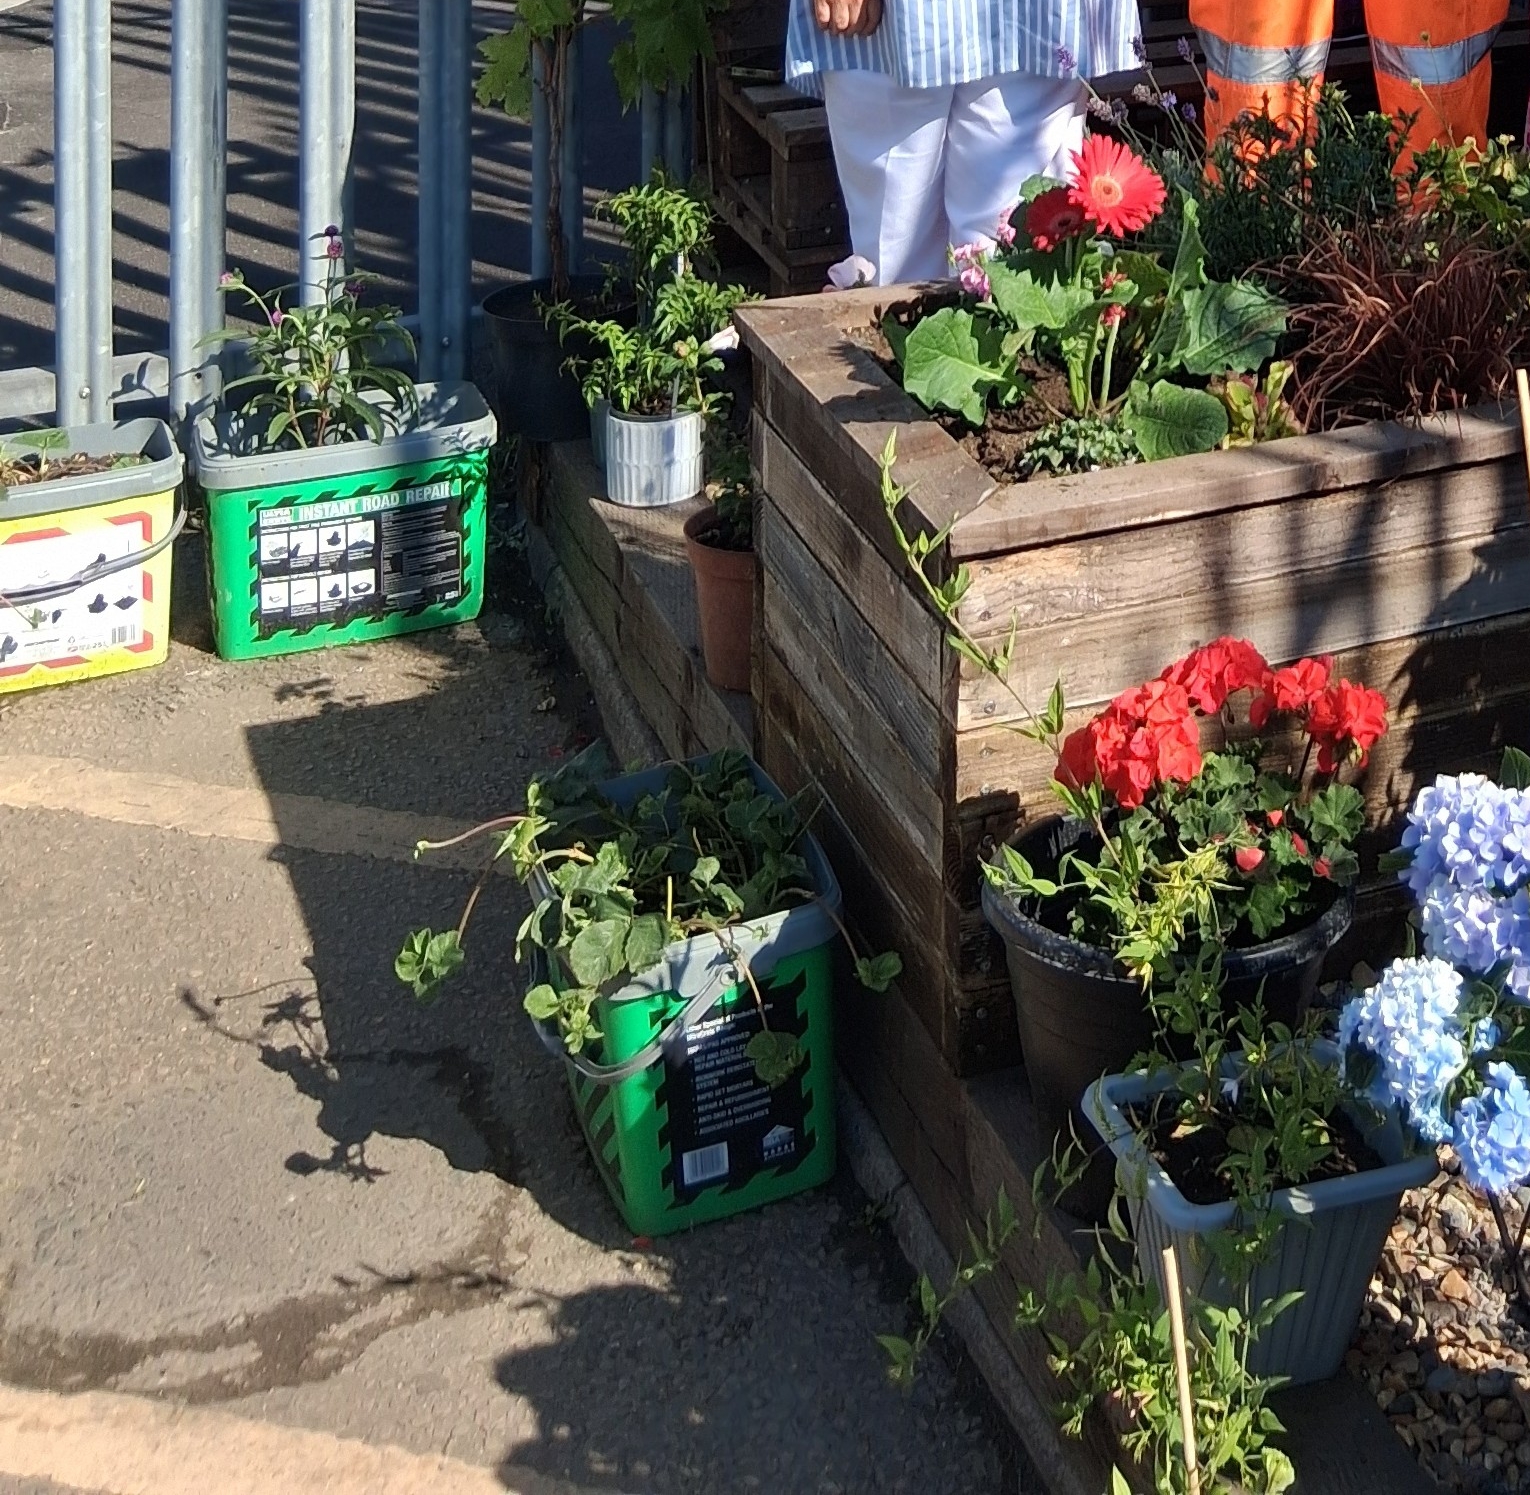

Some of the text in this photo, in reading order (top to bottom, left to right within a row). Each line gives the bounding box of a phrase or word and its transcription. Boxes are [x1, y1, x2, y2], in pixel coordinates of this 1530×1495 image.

[301, 481, 451, 521] INSTANT ROAD REPAIR
